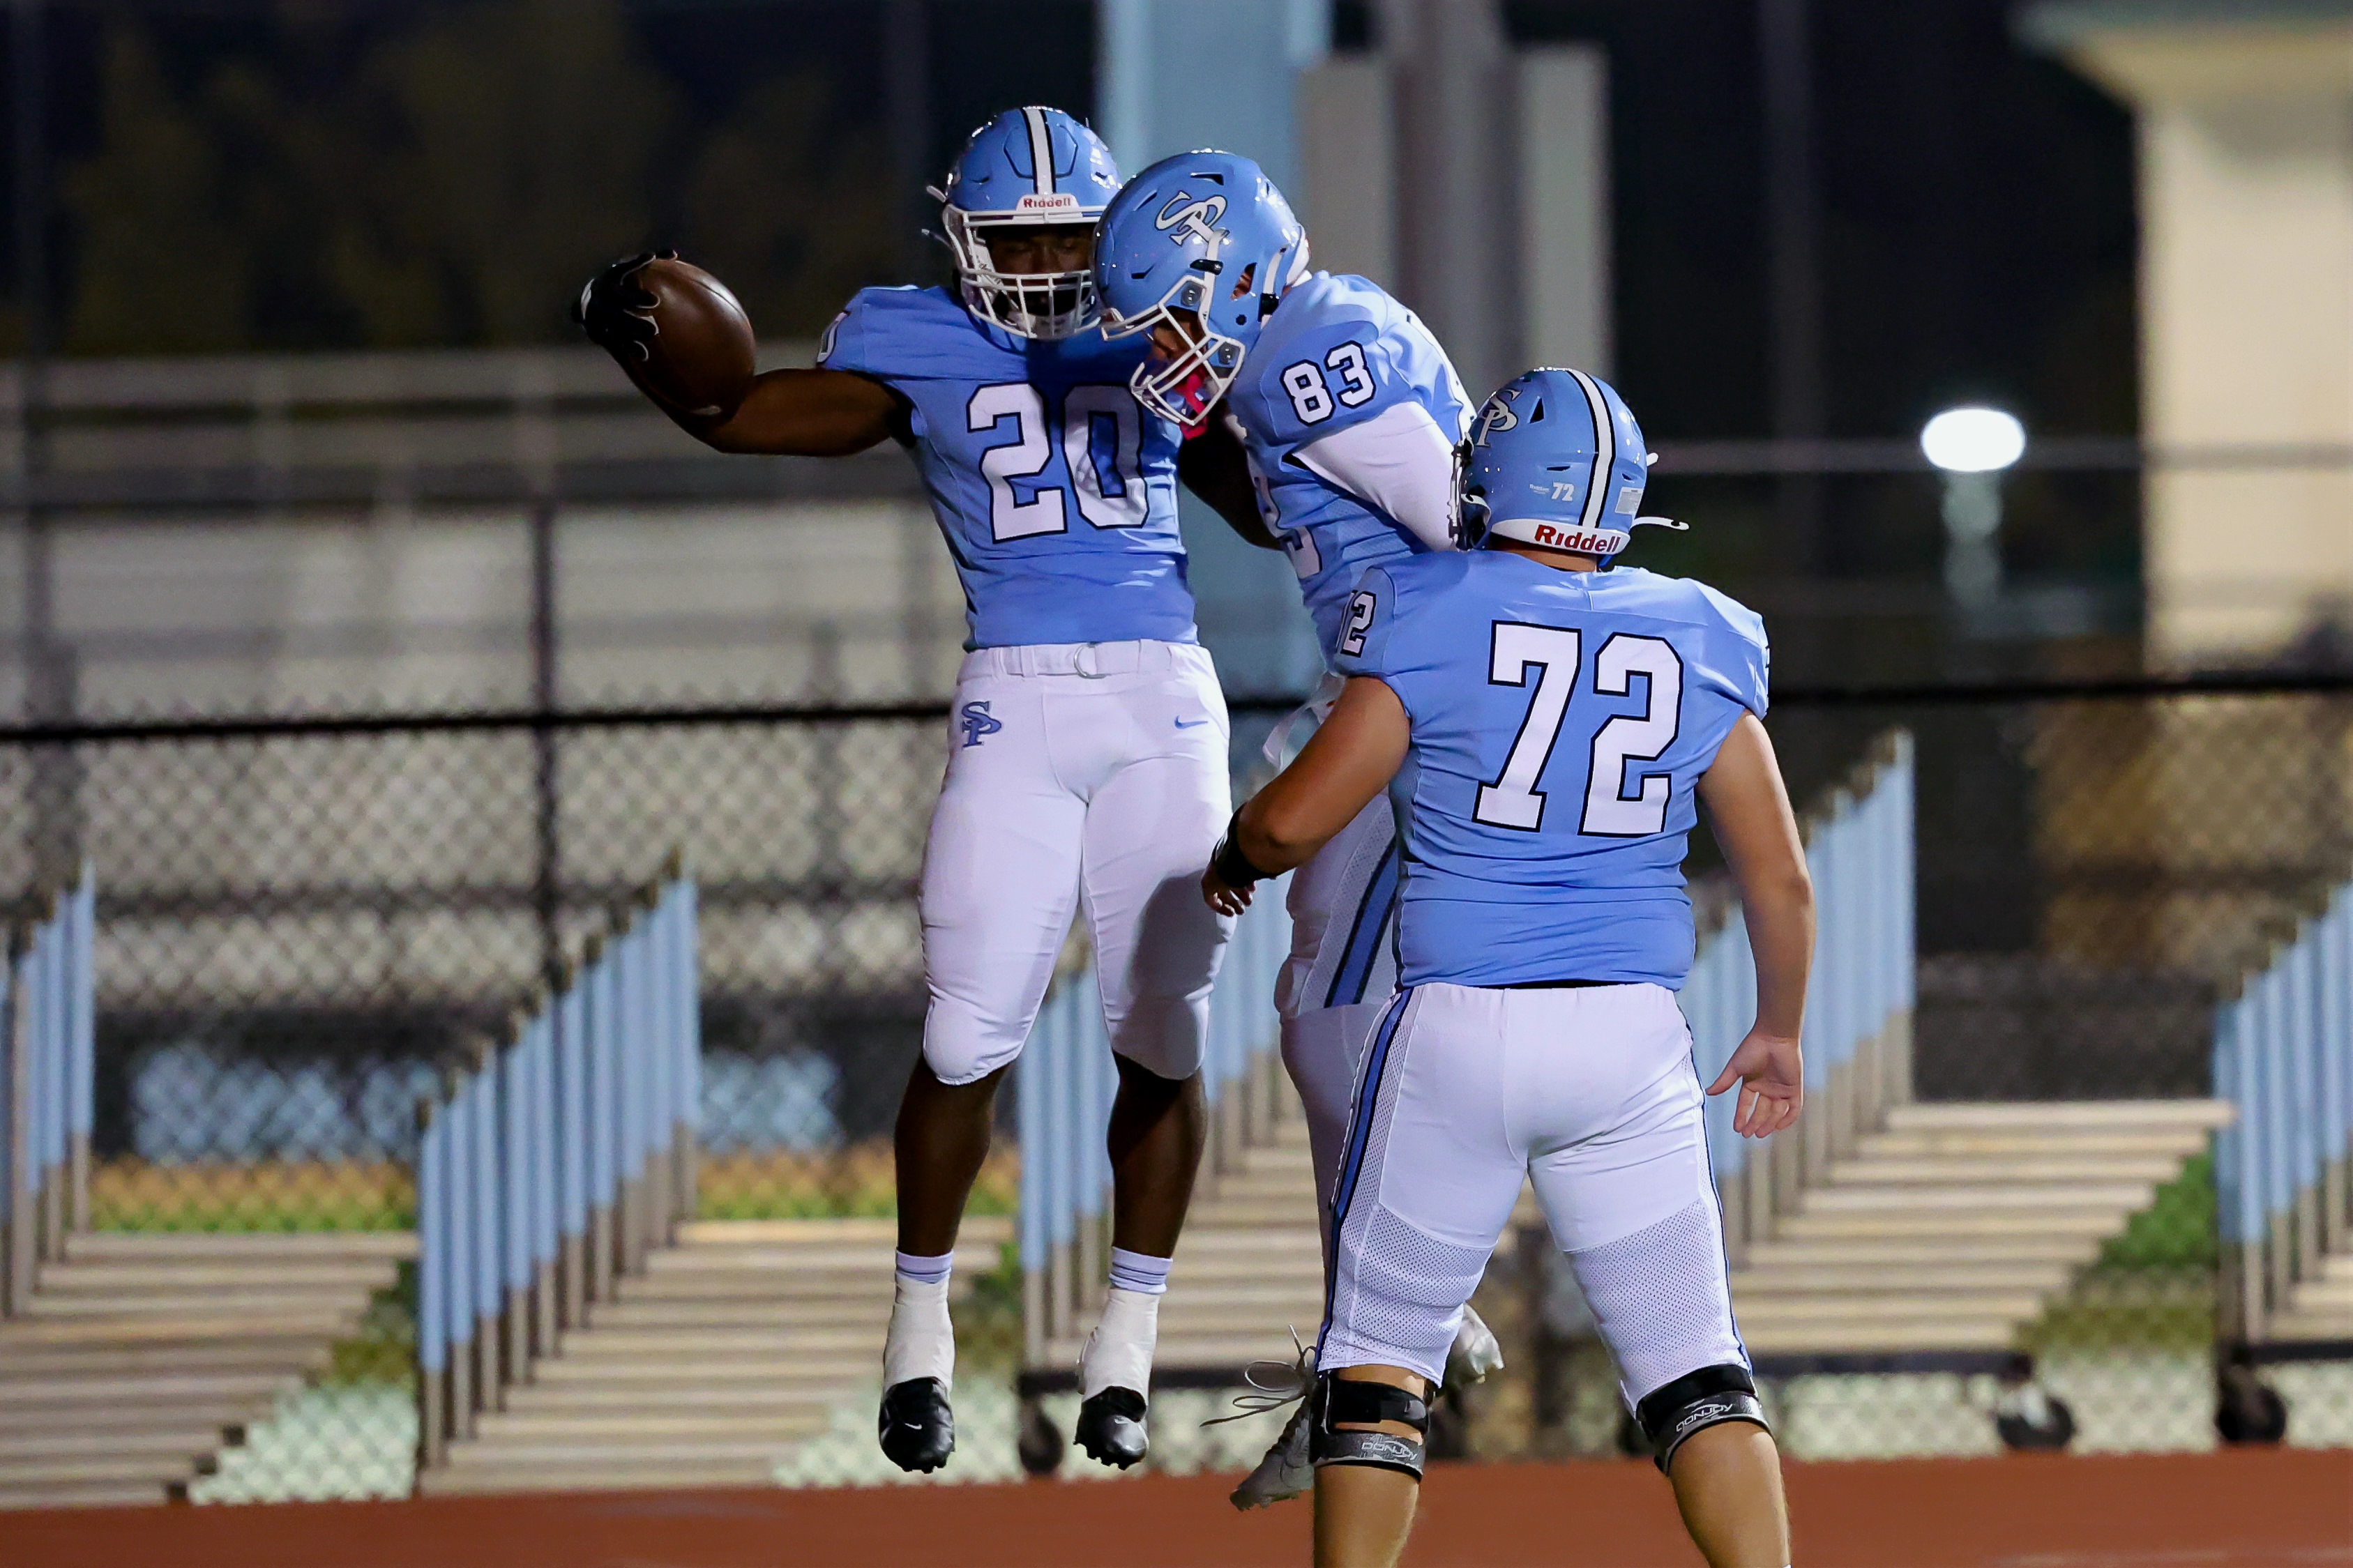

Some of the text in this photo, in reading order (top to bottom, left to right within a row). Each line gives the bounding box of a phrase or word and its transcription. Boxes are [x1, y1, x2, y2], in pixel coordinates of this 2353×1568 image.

[1023, 197, 1071, 208] Riddell
[1280, 340, 1376, 426] 83
[967, 383, 1149, 542] 20
[1551, 482, 1575, 501] 72
[1534, 524, 1621, 553] Riddell
[1335, 590, 1377, 658] 2
[1471, 620, 1684, 837] 72
